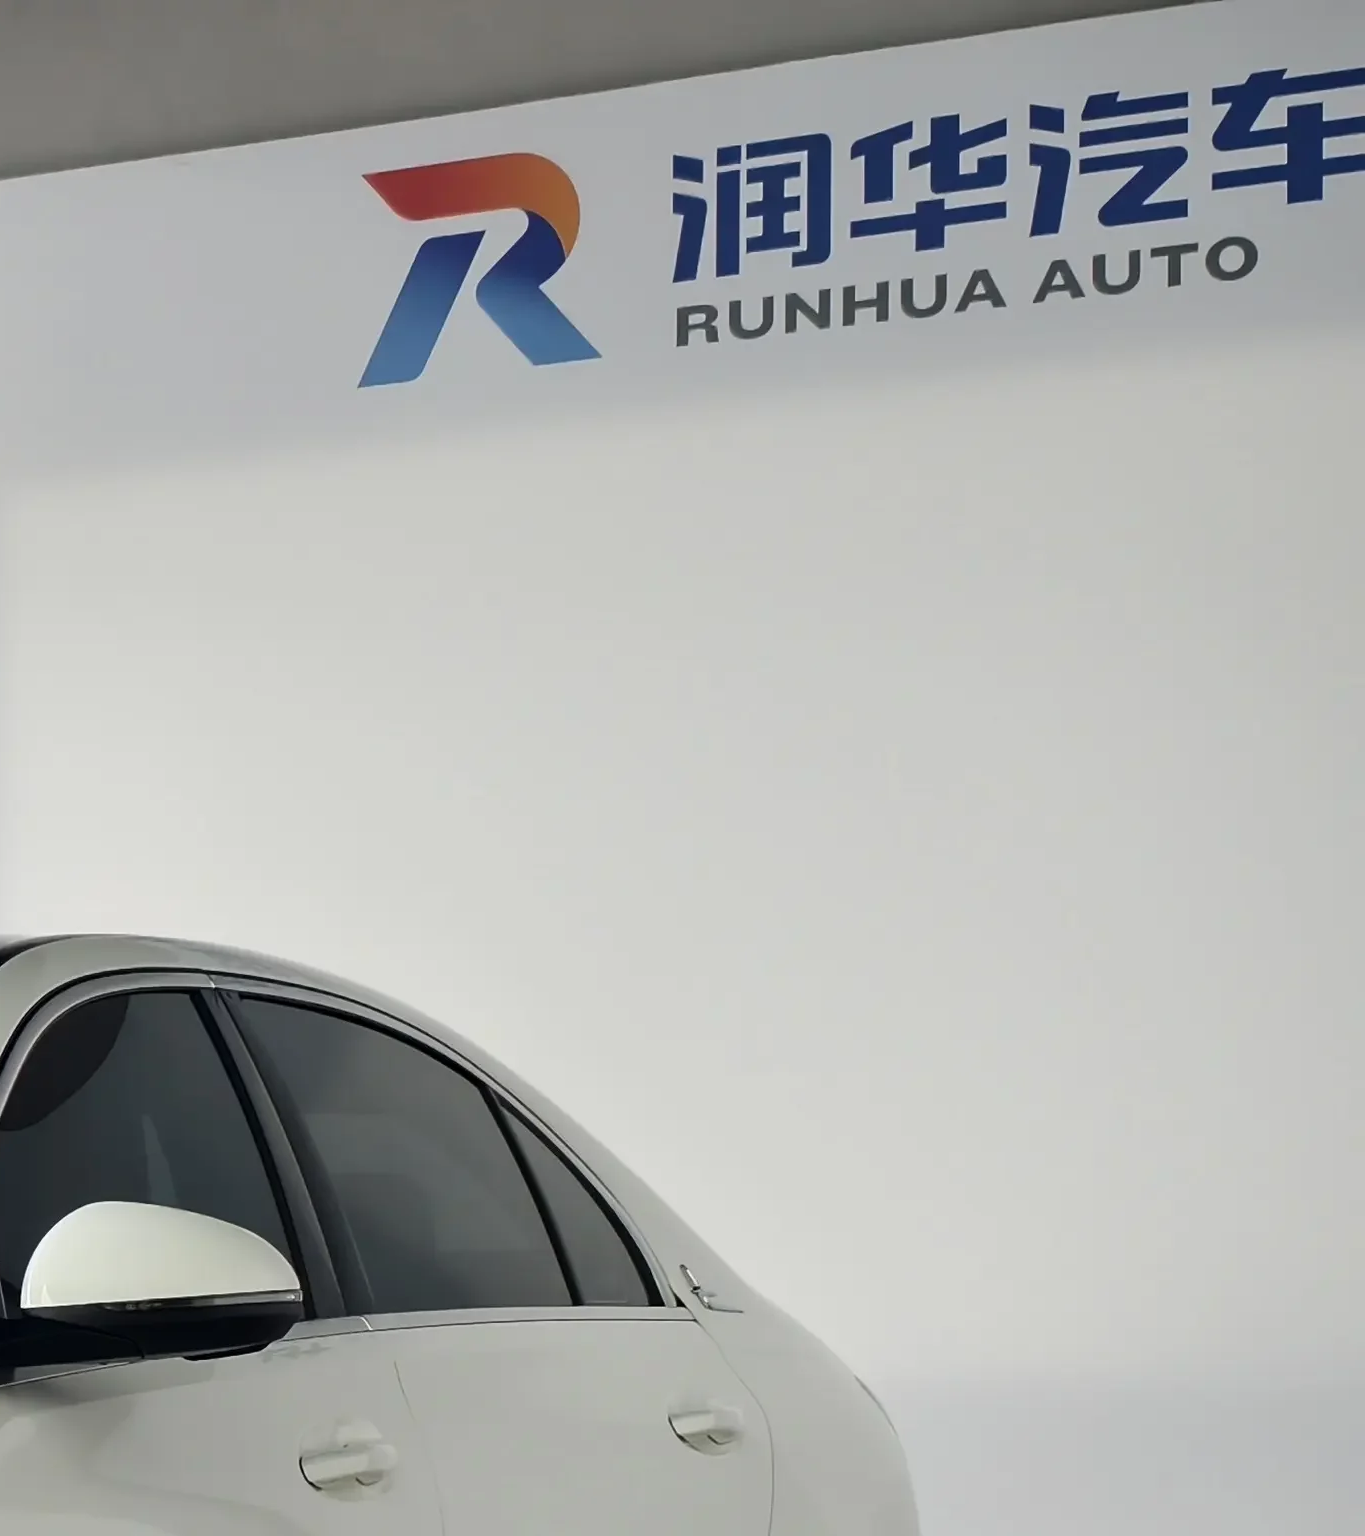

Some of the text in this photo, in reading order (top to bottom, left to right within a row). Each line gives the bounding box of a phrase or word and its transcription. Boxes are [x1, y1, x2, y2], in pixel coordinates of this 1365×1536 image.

[671, 67, 1365, 283] 润华汽车
[675, 235, 1260, 348] RUNHUA AUTO
